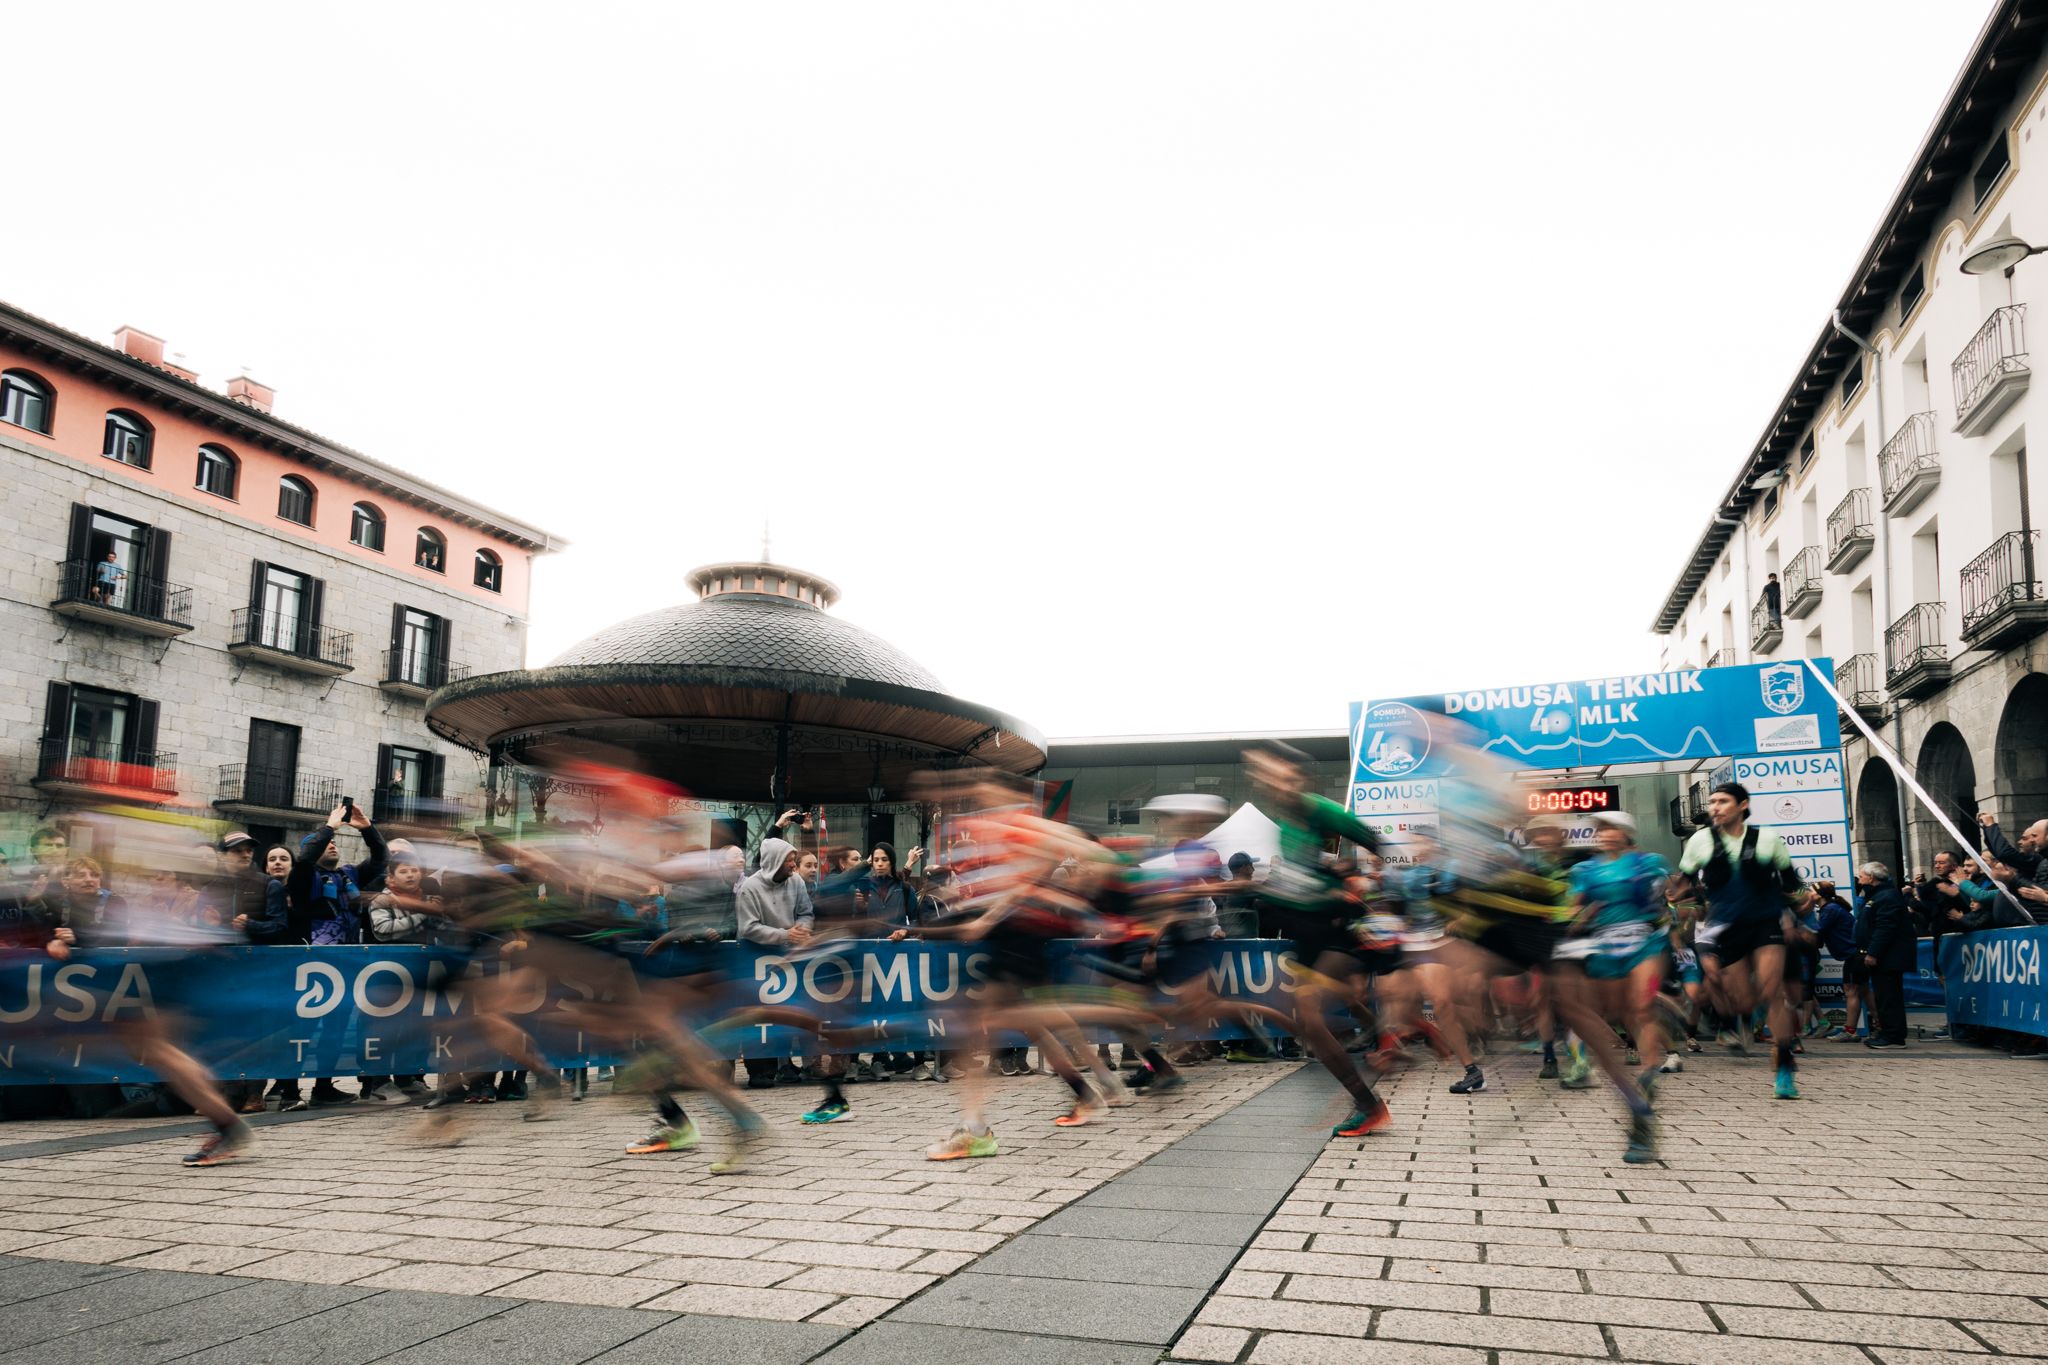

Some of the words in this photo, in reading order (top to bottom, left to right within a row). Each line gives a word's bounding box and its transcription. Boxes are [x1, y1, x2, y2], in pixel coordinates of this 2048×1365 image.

[1444, 684, 1574, 714] DOMUSA
[1586, 670, 1704, 701] TEKNIK
[1581, 702, 1639, 726] MLK
[1737, 757, 1839, 778] DOMUSA
[1355, 784, 1436, 801] DOMUSA
[1741, 777, 1840, 789] EKNIK
[1528, 791, 1607, 811] 0:00:04
[1962, 939, 2040, 986] DOMUSA
[755, 953, 994, 1004] DOMUS
